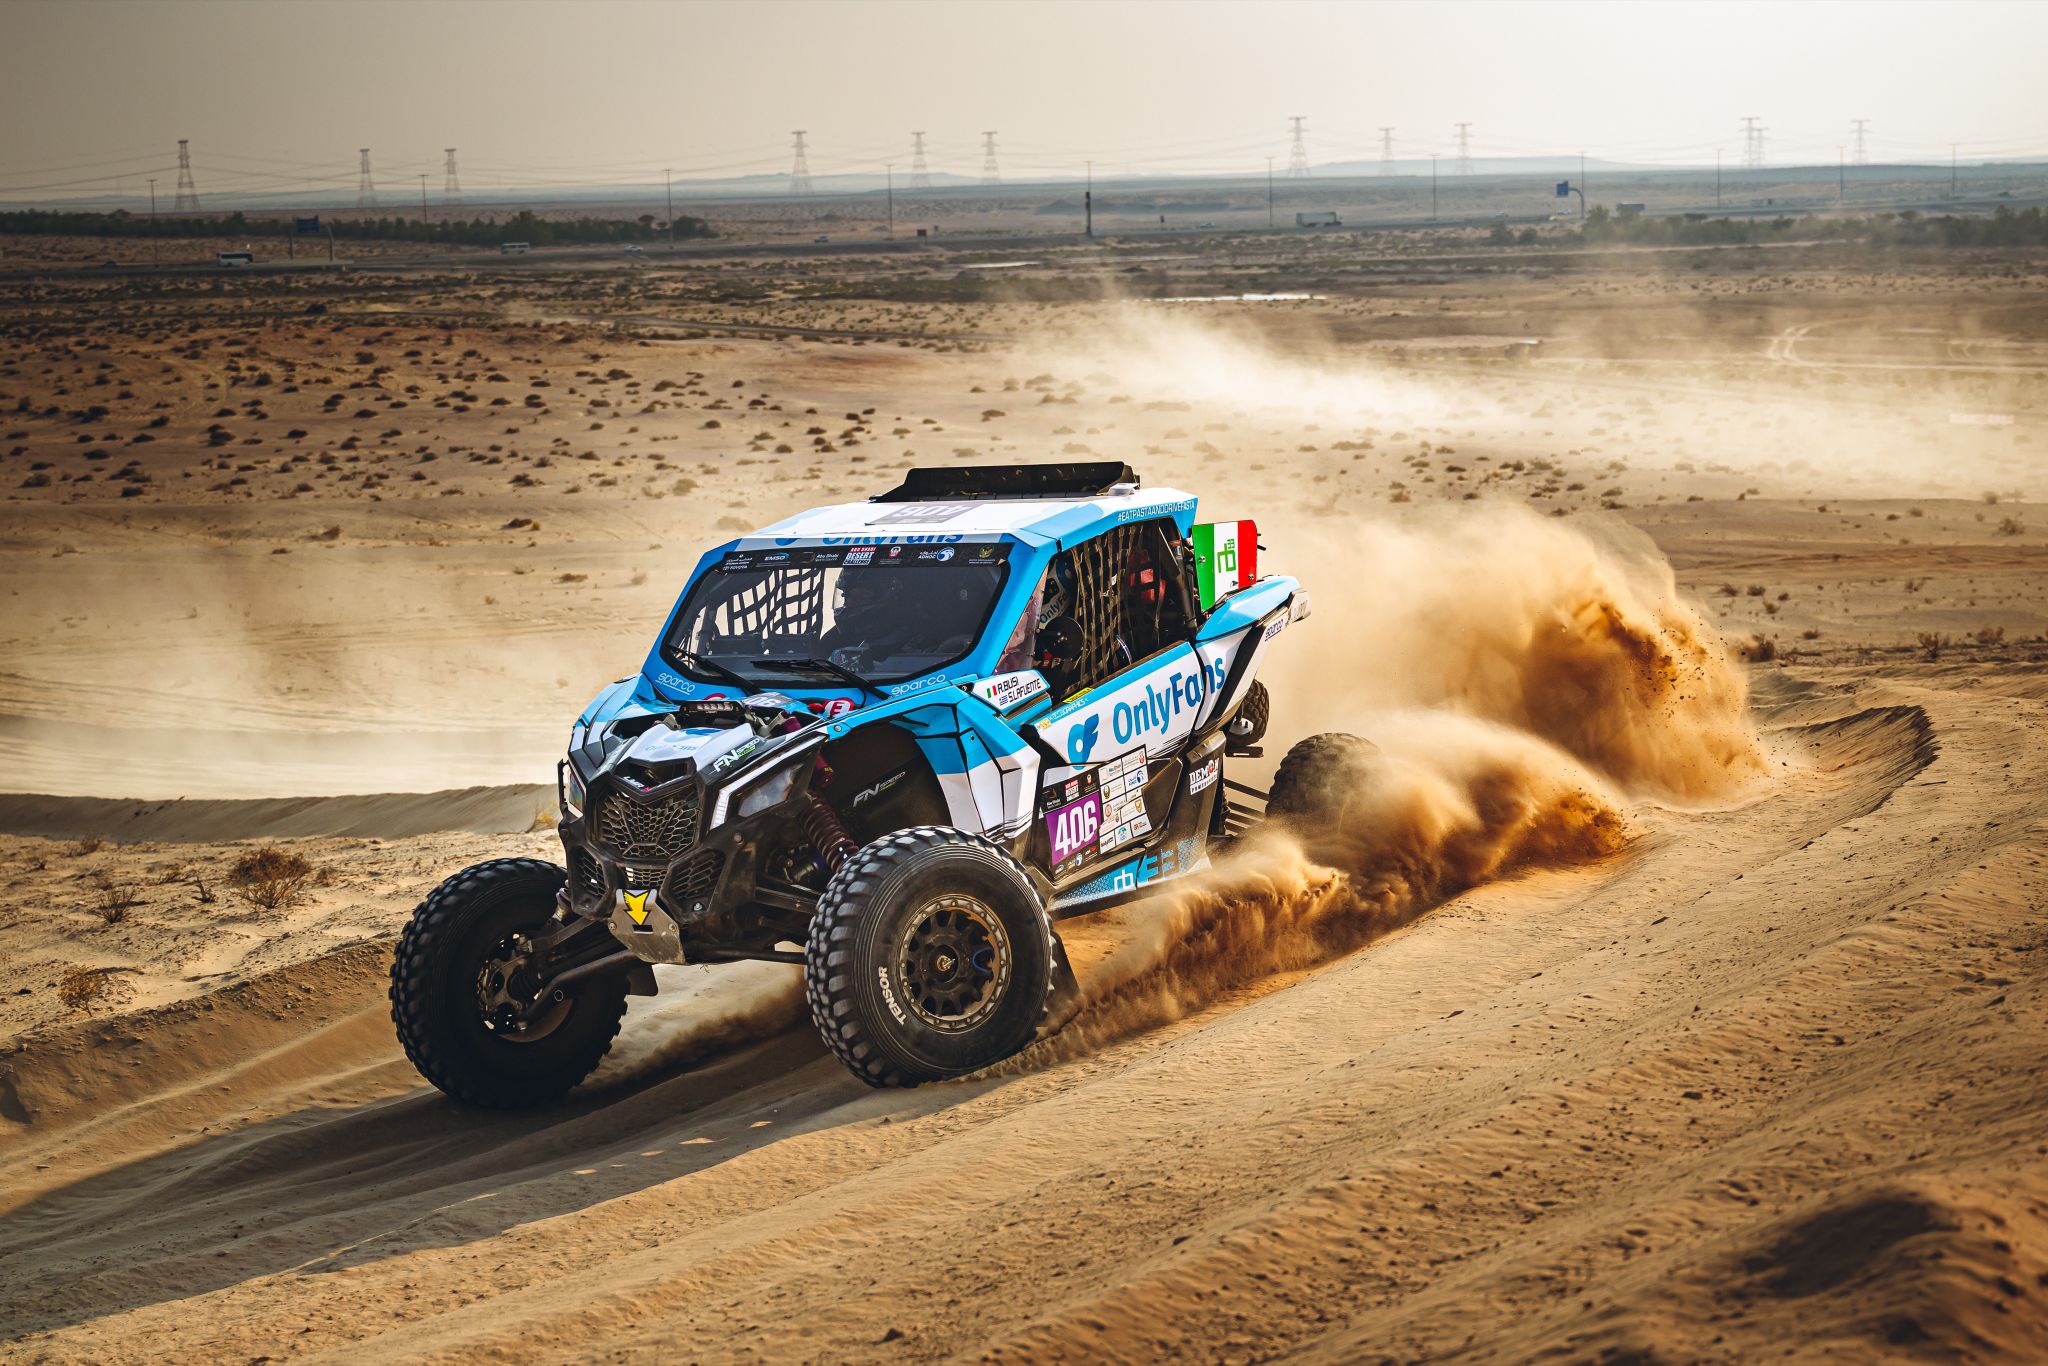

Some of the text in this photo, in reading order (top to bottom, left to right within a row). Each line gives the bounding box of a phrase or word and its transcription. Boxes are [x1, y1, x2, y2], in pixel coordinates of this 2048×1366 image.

[846, 551, 875, 560] DESERT
[658, 672, 696, 693] sparco
[890, 673, 946, 696] sparco
[1008, 678, 1042, 703] S.LAFUENTE
[1113, 657, 1225, 745] OnlyFans
[1054, 799, 1098, 856] 406
[878, 966, 907, 1025] TENSOR
